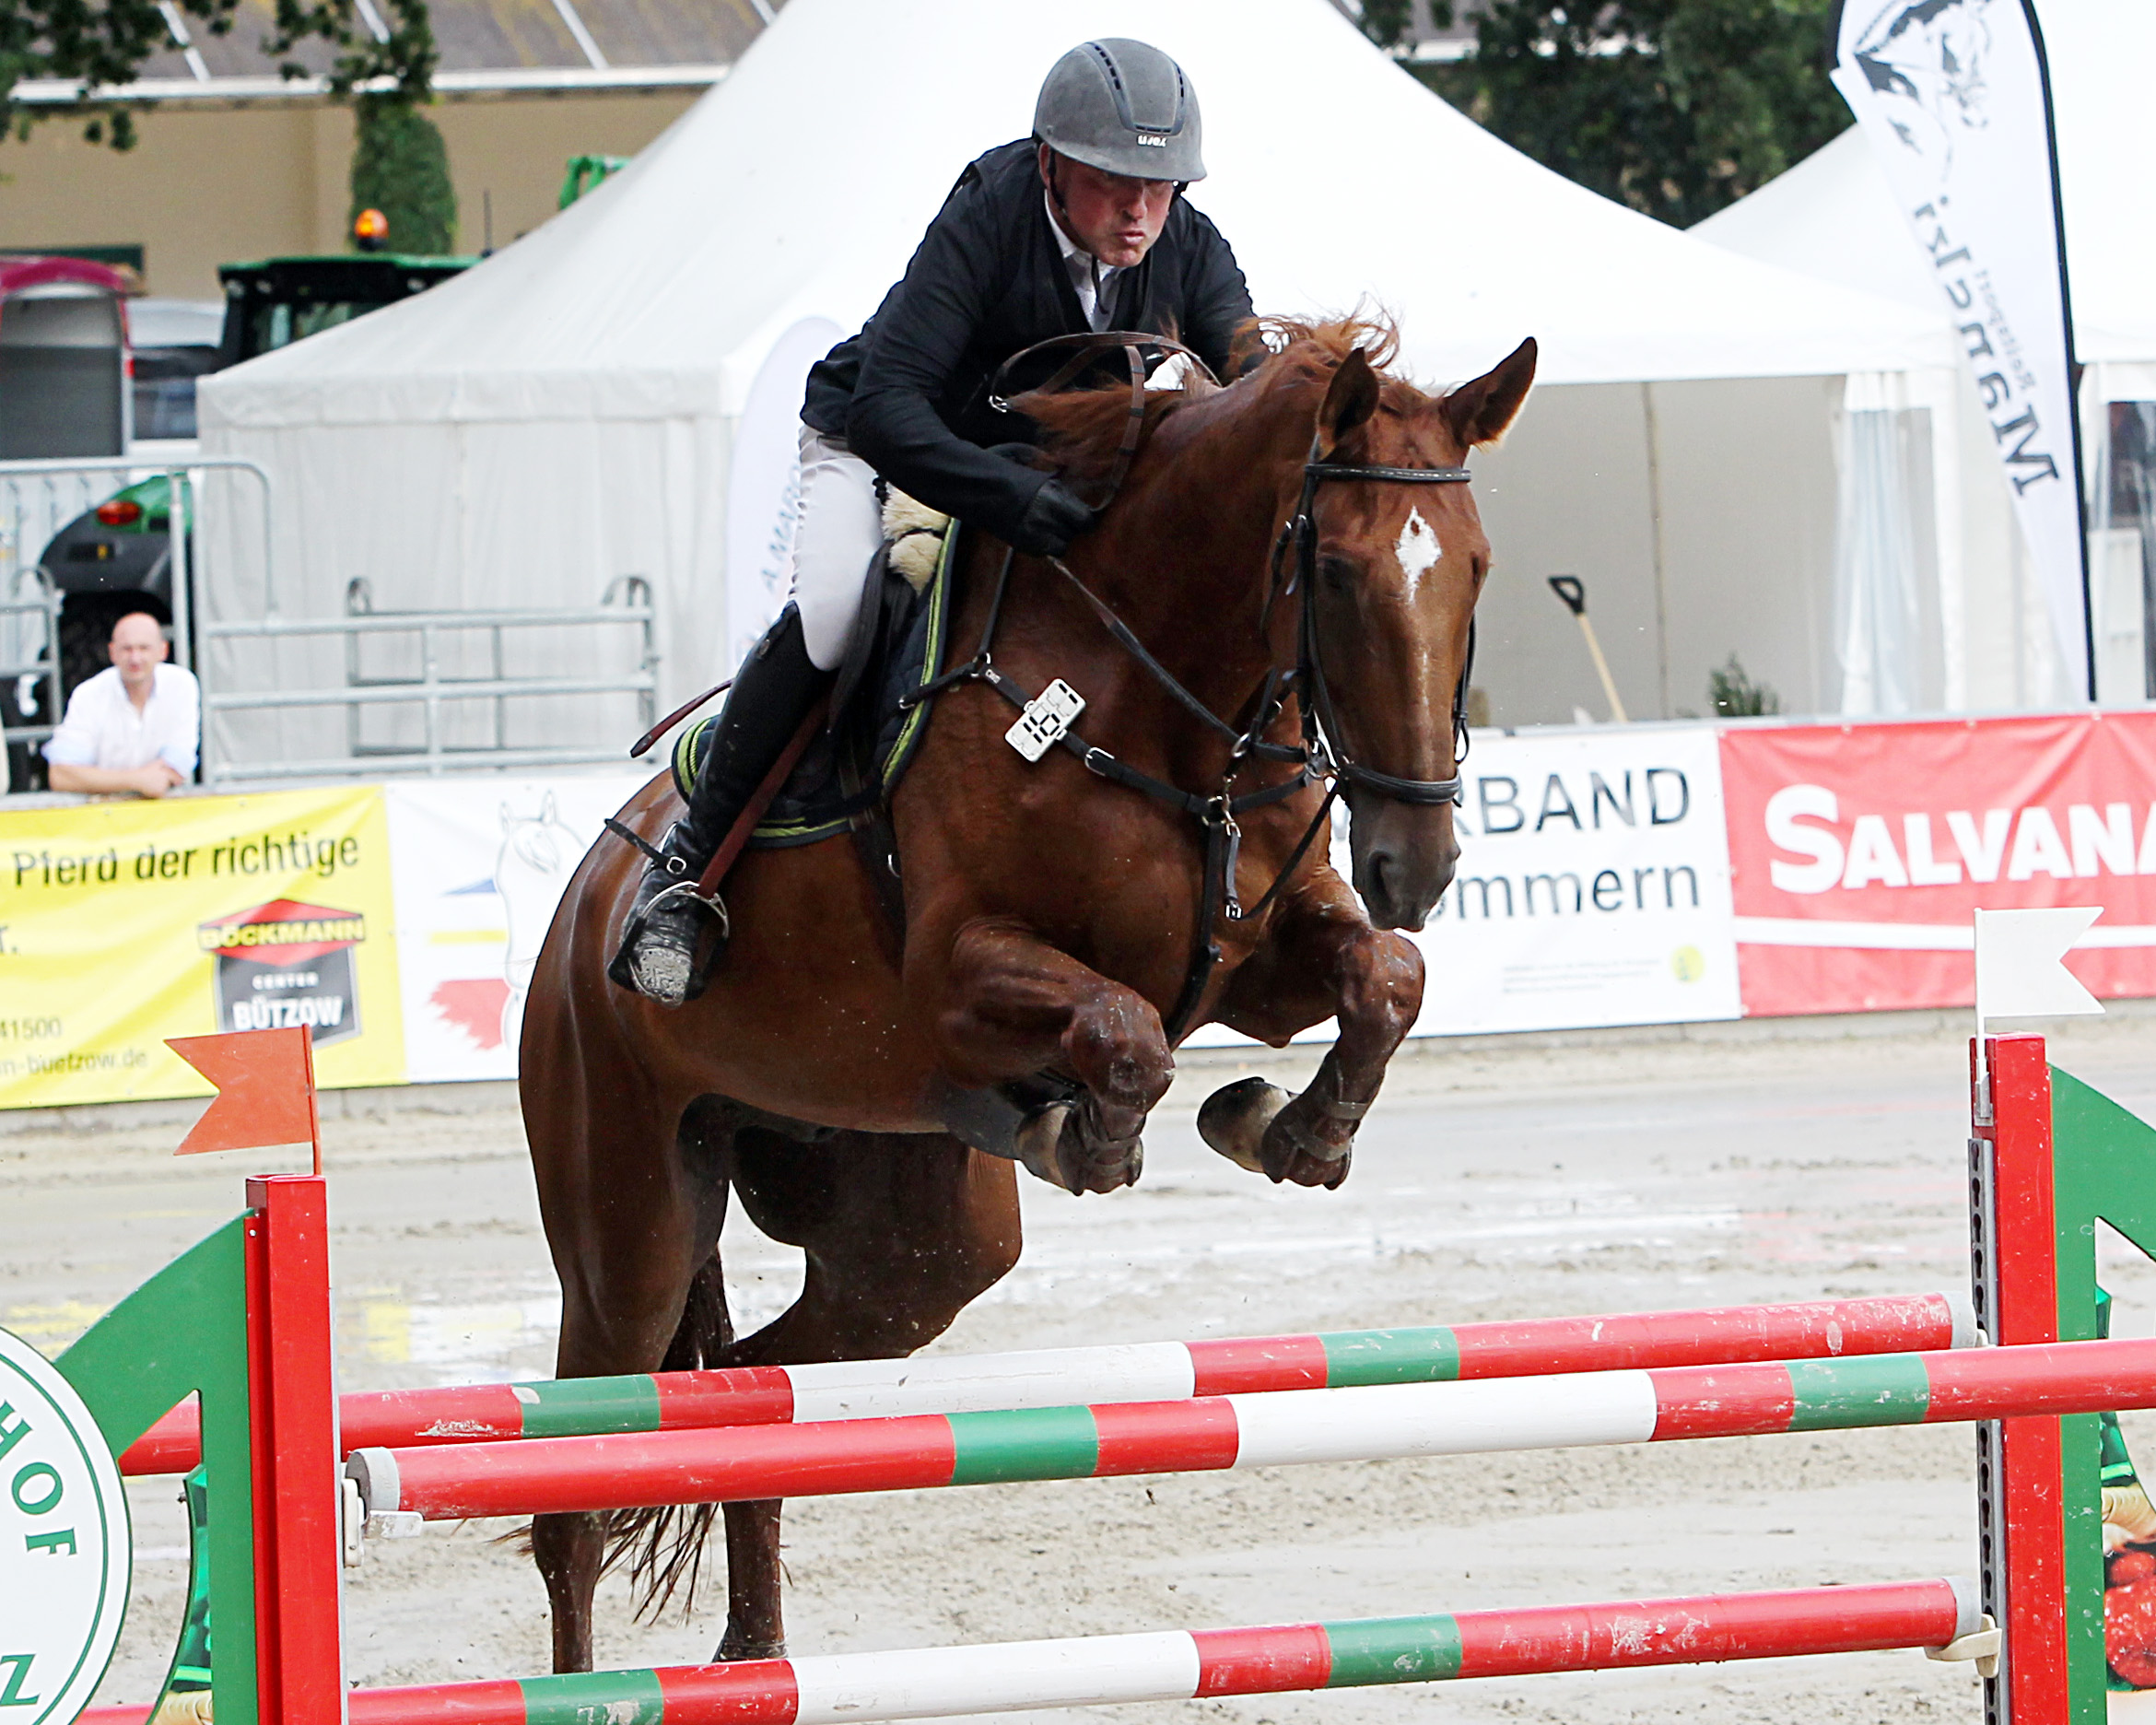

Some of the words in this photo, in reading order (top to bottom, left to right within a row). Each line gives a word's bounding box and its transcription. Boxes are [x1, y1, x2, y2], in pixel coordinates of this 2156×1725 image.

[13, 845, 118, 886] Pferd
[135, 843, 198, 879] der
[211, 831, 360, 877] richtige
[1764, 783, 2156, 894] SALVAN
[199, 919, 364, 950] BÖCKMANN
[232, 994, 344, 1030] BÜTZOW
